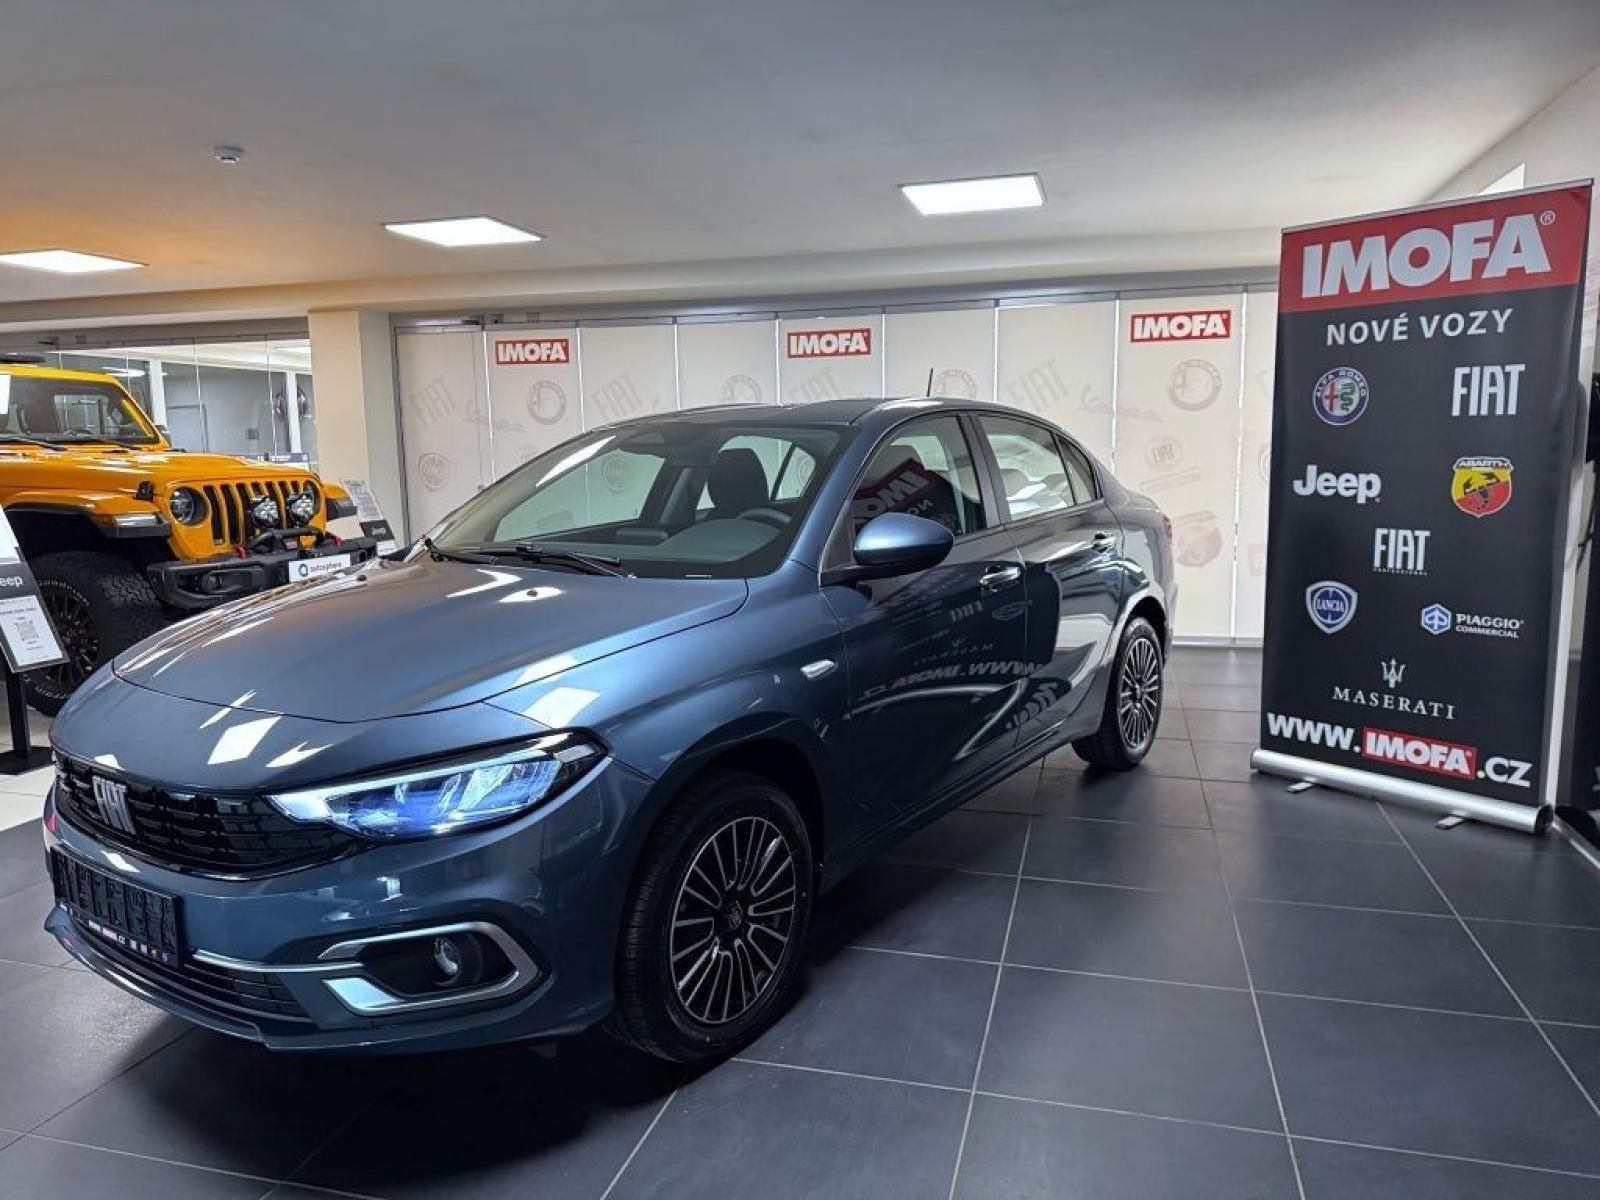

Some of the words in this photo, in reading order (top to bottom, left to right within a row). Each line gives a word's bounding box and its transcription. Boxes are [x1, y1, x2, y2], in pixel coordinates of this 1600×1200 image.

[1132, 313, 1228, 340] IMOFA
[1326, 313, 1409, 346] NOVÉ
[1420, 309, 1513, 339] VOZY
[497, 342, 567, 361] IMOFA
[790, 332, 869, 355] IMOFA
[1451, 364, 1526, 417] FIAT
[1293, 465, 1381, 503] Jeep
[1374, 528, 1431, 571] FIAT
[0, 575, 23, 588] eep
[1456, 614, 1520, 629] PIAGGIO
[1456, 625, 1519, 638] COMMERCIAL
[1332, 686, 1455, 720] MASERATI
[92, 775, 137, 835] FIAT
